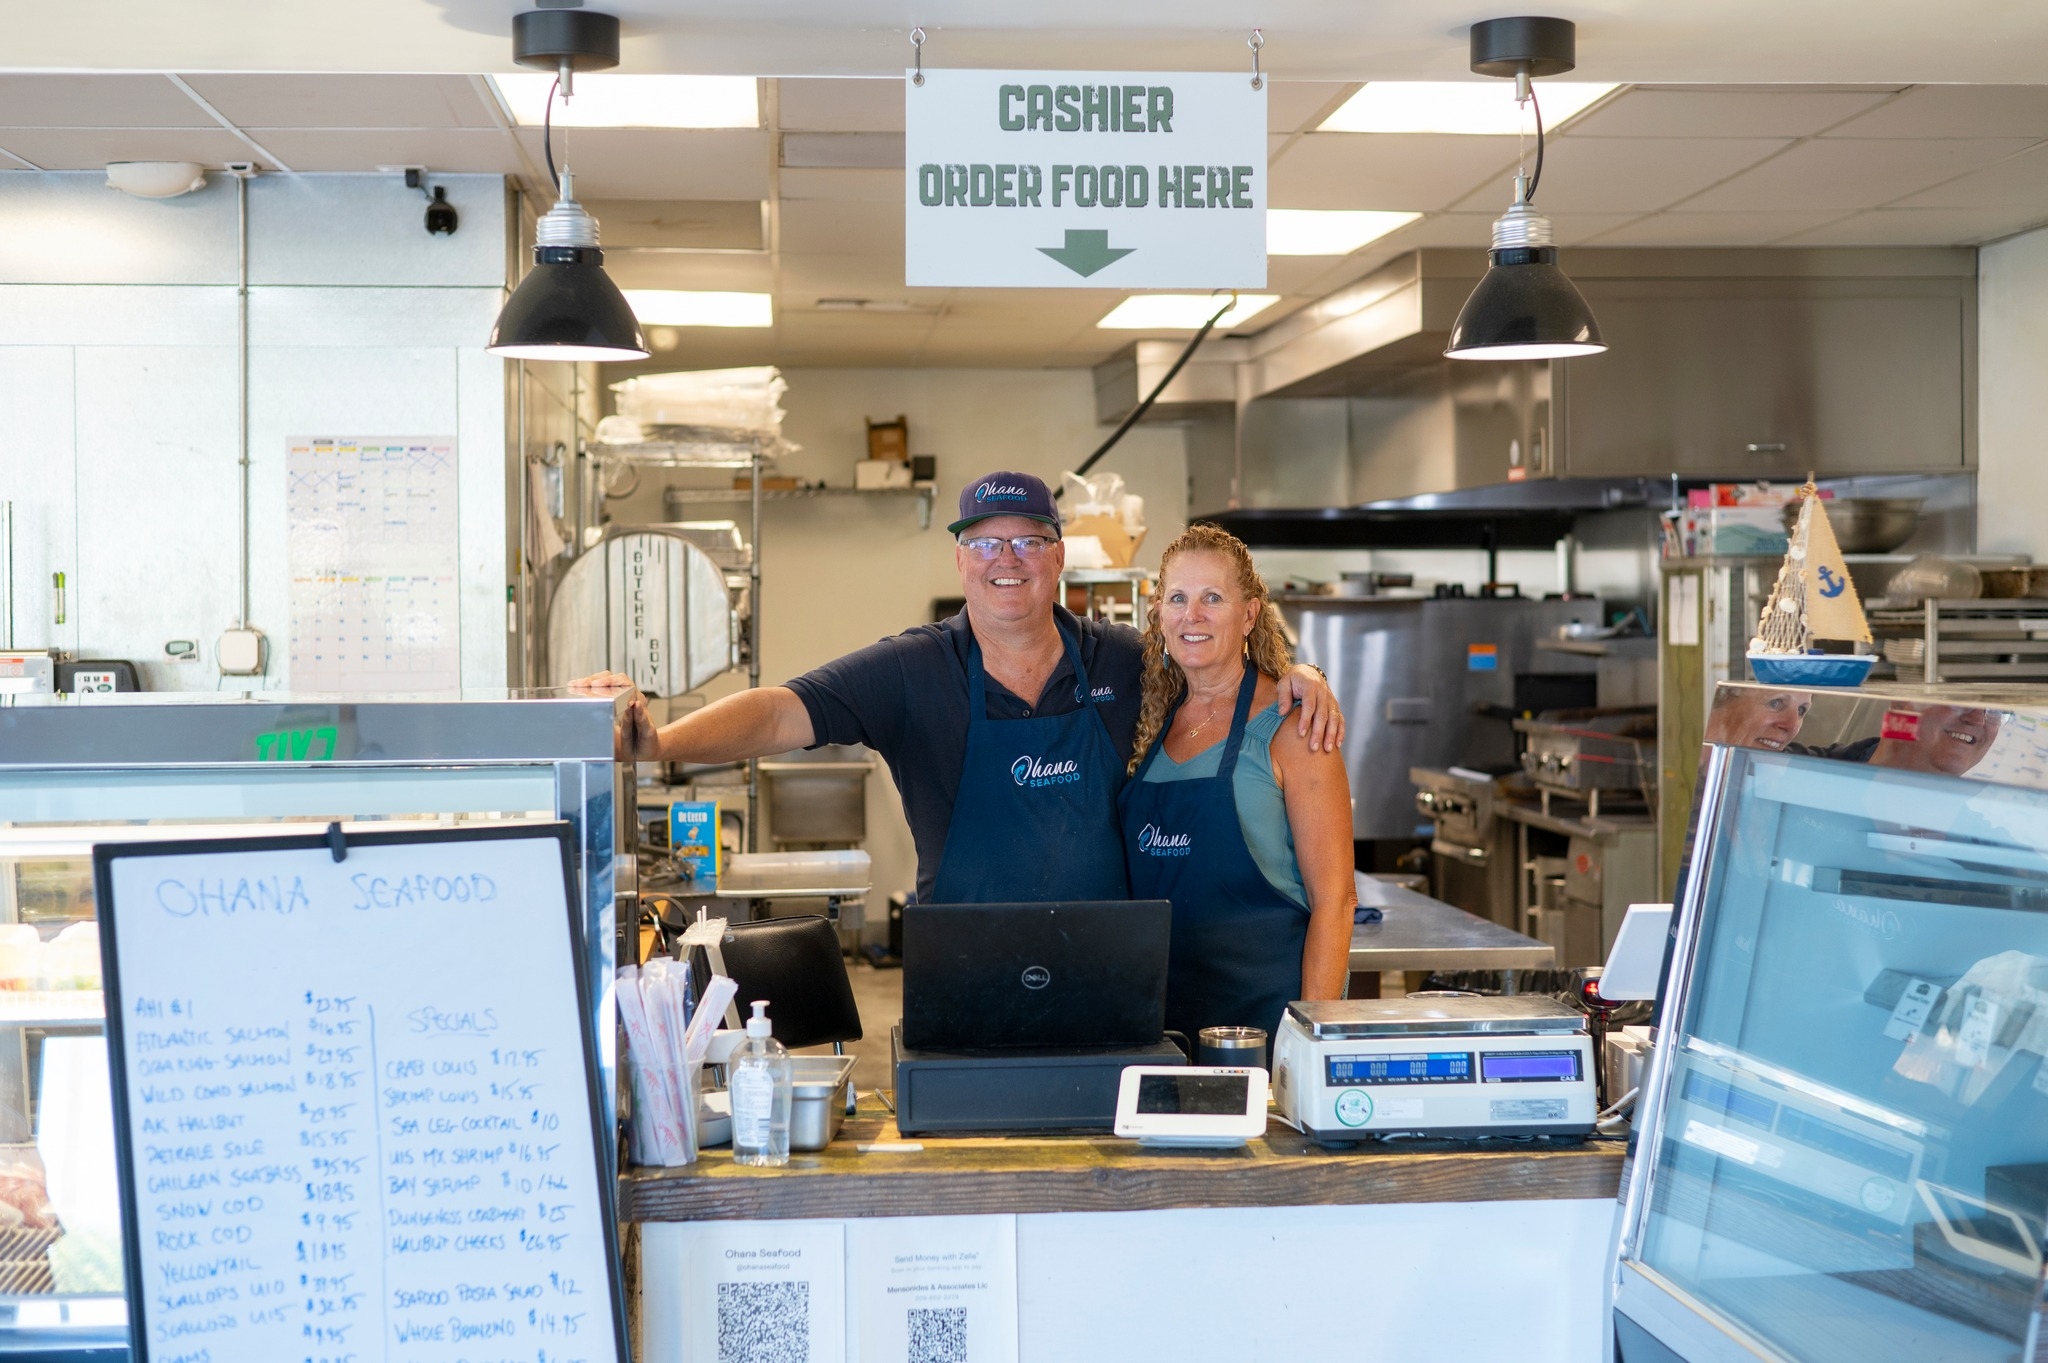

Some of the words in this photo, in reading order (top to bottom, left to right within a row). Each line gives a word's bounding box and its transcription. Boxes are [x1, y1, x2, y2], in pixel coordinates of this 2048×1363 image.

[999, 84, 1174, 132] CASHIER
[918, 163, 1041, 207] ORDER
[1051, 165, 1149, 208] FOOD
[1158, 165, 1253, 209] HERE
[975, 481, 1027, 503] Ohana
[633, 551, 644, 639] BUTCHER
[1011, 755, 1077, 786] Ohana
[1029, 772, 1080, 787] SEAFOOD
[1138, 823, 1191, 852] Ohana
[1150, 847, 1190, 856] SEAFOOD
[155, 875, 309, 917] OHANA
[351, 873, 497, 910] SEAFOOD
[407, 1006, 499, 1033] SPECIALS
[137, 1028, 214, 1052] ATLANTIC
[224, 1020, 290, 1044] SALMON
[224, 1048, 291, 1070] SALMON
[386, 1060, 424, 1079] CRAB
[433, 1060, 477, 1076] LOUIS
[140, 1085, 185, 1103] WILD
[238, 1075, 296, 1097] SALMON
[142, 1118, 169, 1134] AK
[177, 1115, 245, 1133] HALIBUT
[531, 1109, 559, 1131] $10
[224, 1139, 265, 1159] SOLE
[452, 1146, 503, 1165] SHRIMP
[388, 1176, 416, 1196] BAY
[157, 1200, 212, 1221] SNOW
[222, 1195, 264, 1215] COD
[156, 1230, 200, 1251] ROCK
[211, 1225, 252, 1244] COD
[392, 1235, 449, 1253] HALIBUT
[455, 1235, 505, 1252] CHEEKS
[725, 1249, 757, 1259] Ohana
[759, 1248, 801, 1259] Seafood
[894, 1256, 914, 1264] Send
[915, 1254, 940, 1265] Money
[942, 1253, 957, 1261] with
[160, 1257, 262, 1285] YELLOWTAIL
[736, 1263, 790, 1272] @ohanaseafood
[393, 1289, 449, 1309] SEAFOOD
[456, 1283, 496, 1301] PASTA
[503, 1282, 543, 1301] SALAD
[937, 1283, 976, 1291] Associates
[394, 1321, 445, 1344] WHOLE
